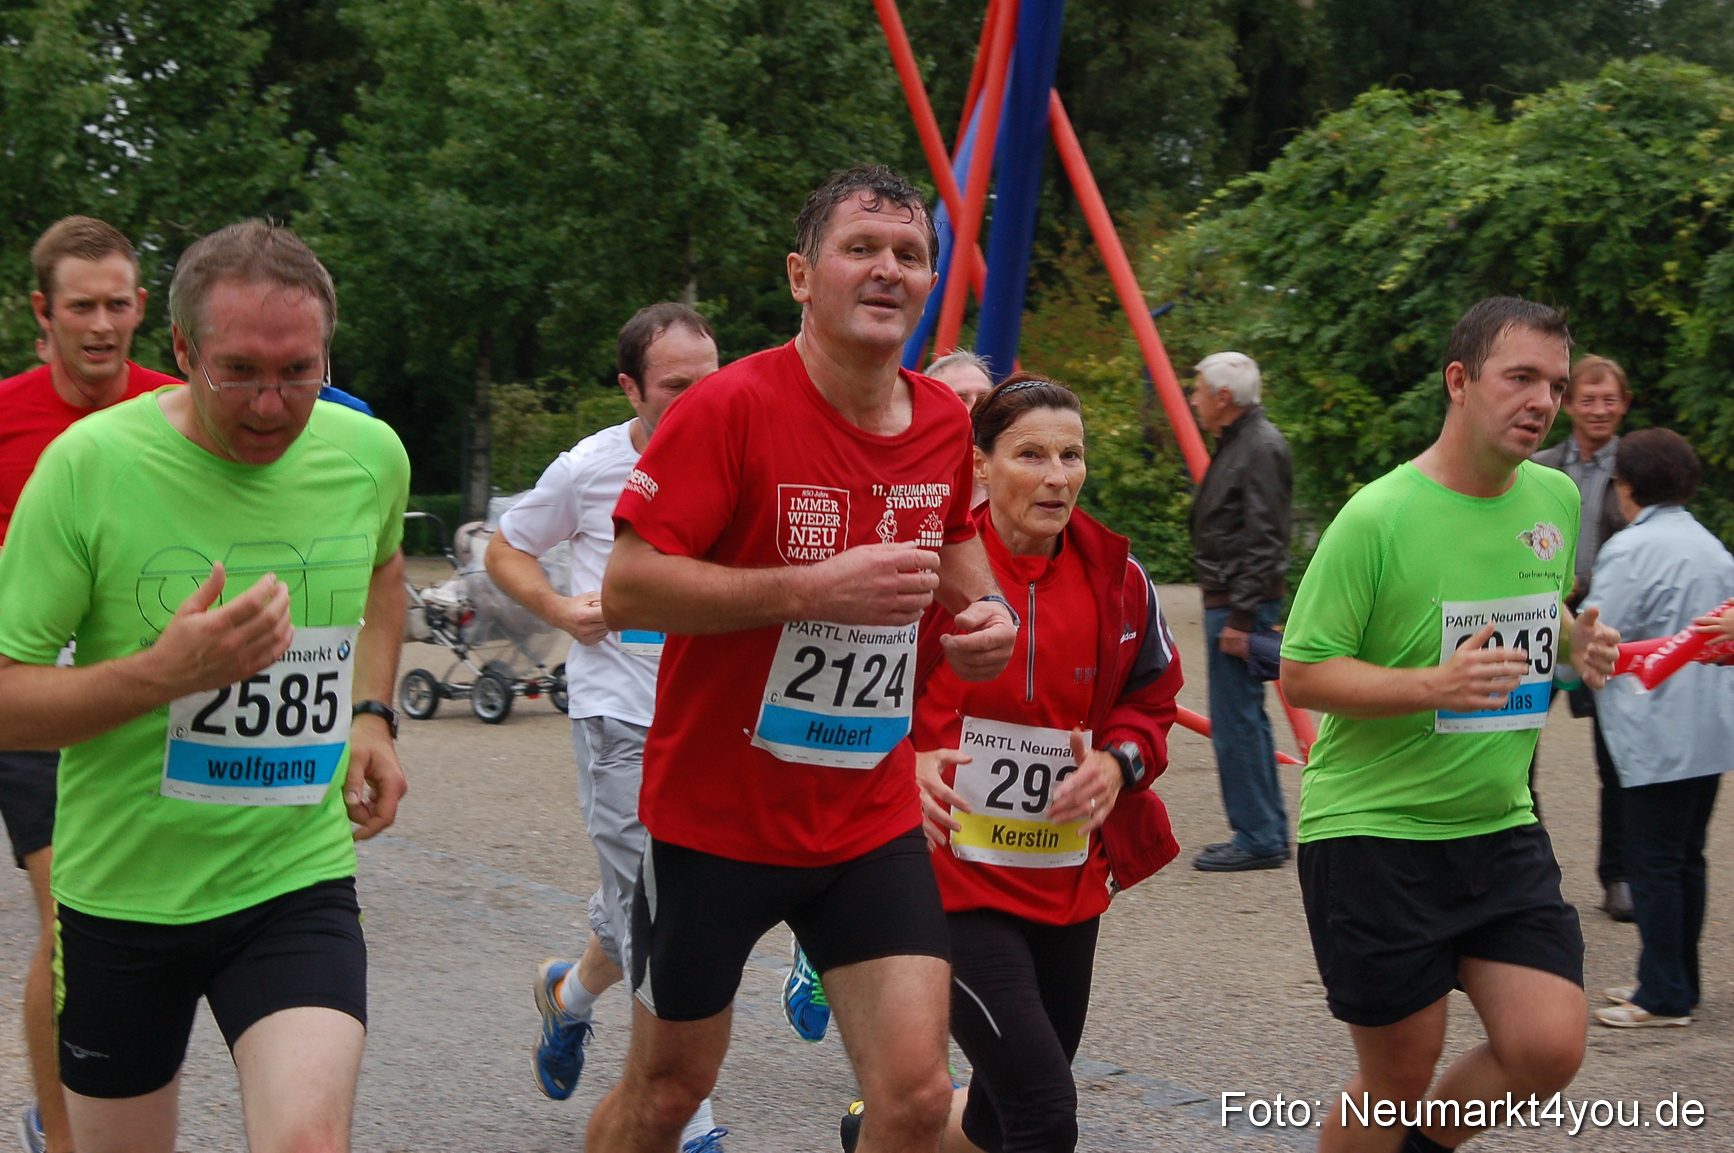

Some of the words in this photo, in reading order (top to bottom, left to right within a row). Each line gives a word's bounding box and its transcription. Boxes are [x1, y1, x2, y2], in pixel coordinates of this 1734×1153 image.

[814, 490, 829, 499] Jahre
[872, 484, 887, 497] 11.
[890, 483, 950, 497] NEUMARKTER
[790, 497, 839, 513] IMMER
[885, 496, 943, 509] STADTLAUF
[787, 511, 841, 527] WIEDER
[788, 526, 838, 547] NEU
[786, 546, 836, 561] MARKT
[1445, 613, 1488, 628] PARTL
[1491, 608, 1546, 624] Neumarkt
[787, 621, 843, 641] PARTL
[847, 629, 907, 645] Neumarkt
[783, 645, 909, 708] 2124
[191, 671, 339, 738] 2585
[806, 720, 873, 746] Hubert
[964, 731, 1016, 752] PARTL
[207, 756, 316, 786] wolfgang
[991, 824, 1059, 849] Kerstin
